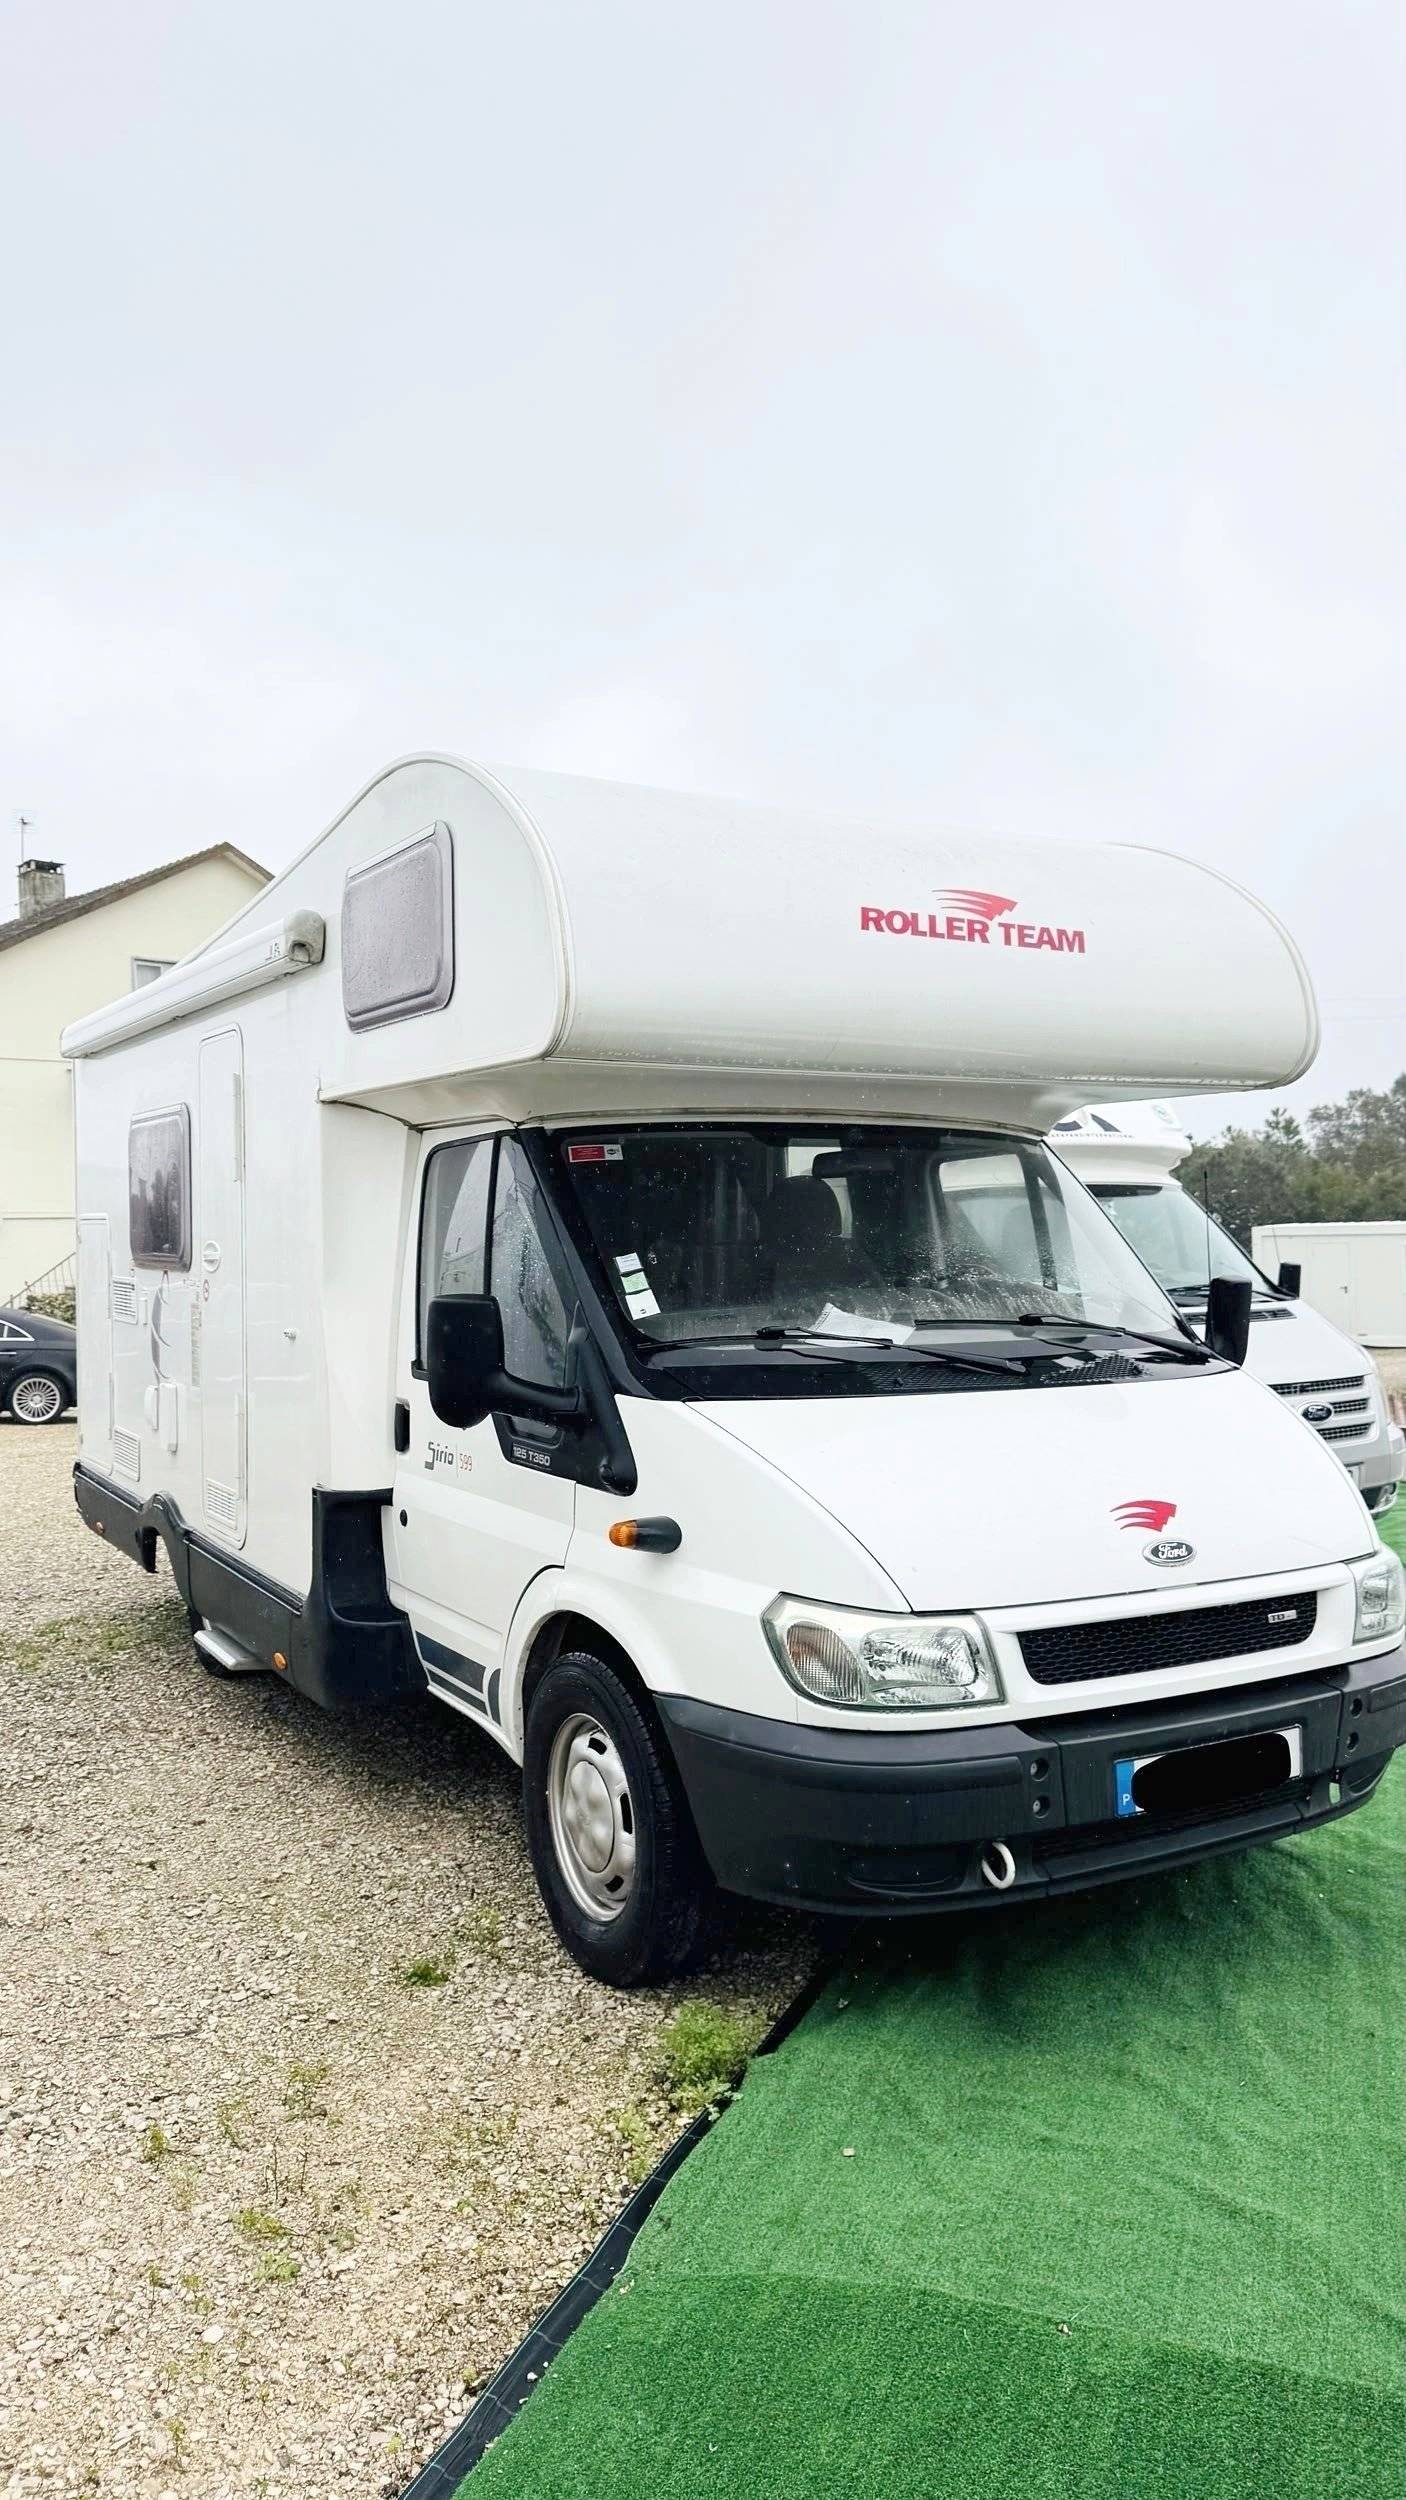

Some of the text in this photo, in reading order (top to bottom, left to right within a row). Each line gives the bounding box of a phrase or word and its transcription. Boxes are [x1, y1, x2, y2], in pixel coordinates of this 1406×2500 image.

[860, 906, 1086, 954] ROLLER TEAM
[424, 1441, 454, 1470] Sirio
[513, 1446, 551, 1466] 125 T350
[1158, 1542, 1188, 1559] Ford
[1122, 1793, 1131, 1807] P
